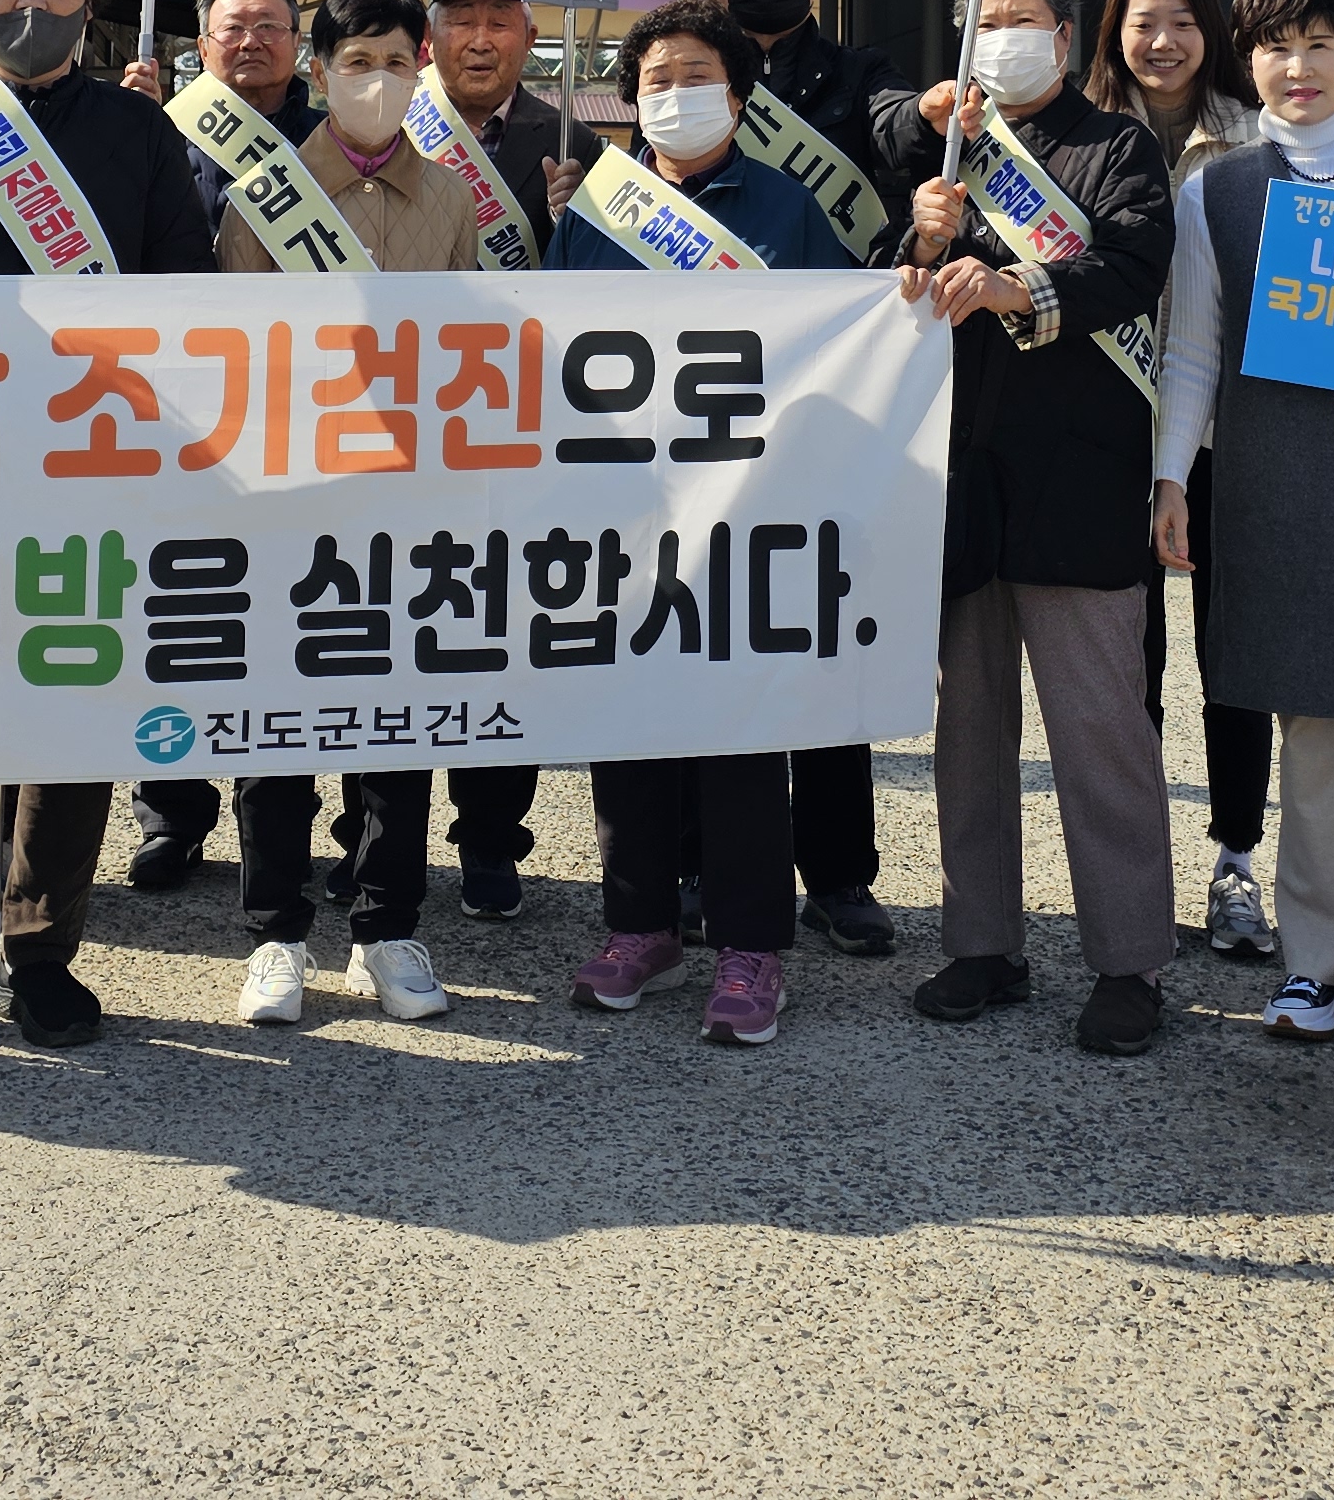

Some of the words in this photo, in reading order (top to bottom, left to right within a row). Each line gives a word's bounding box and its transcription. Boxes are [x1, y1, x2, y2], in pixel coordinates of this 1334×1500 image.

[605, 179, 655, 228] 국가
[639, 205, 714, 270] 암검진
[985, 158, 1047, 228] 암검진
[41, 319, 766, 481] 조기검진으로
[288, 519, 879, 678] 실천합시다.
[203, 702, 525, 755] 진도군보건소
